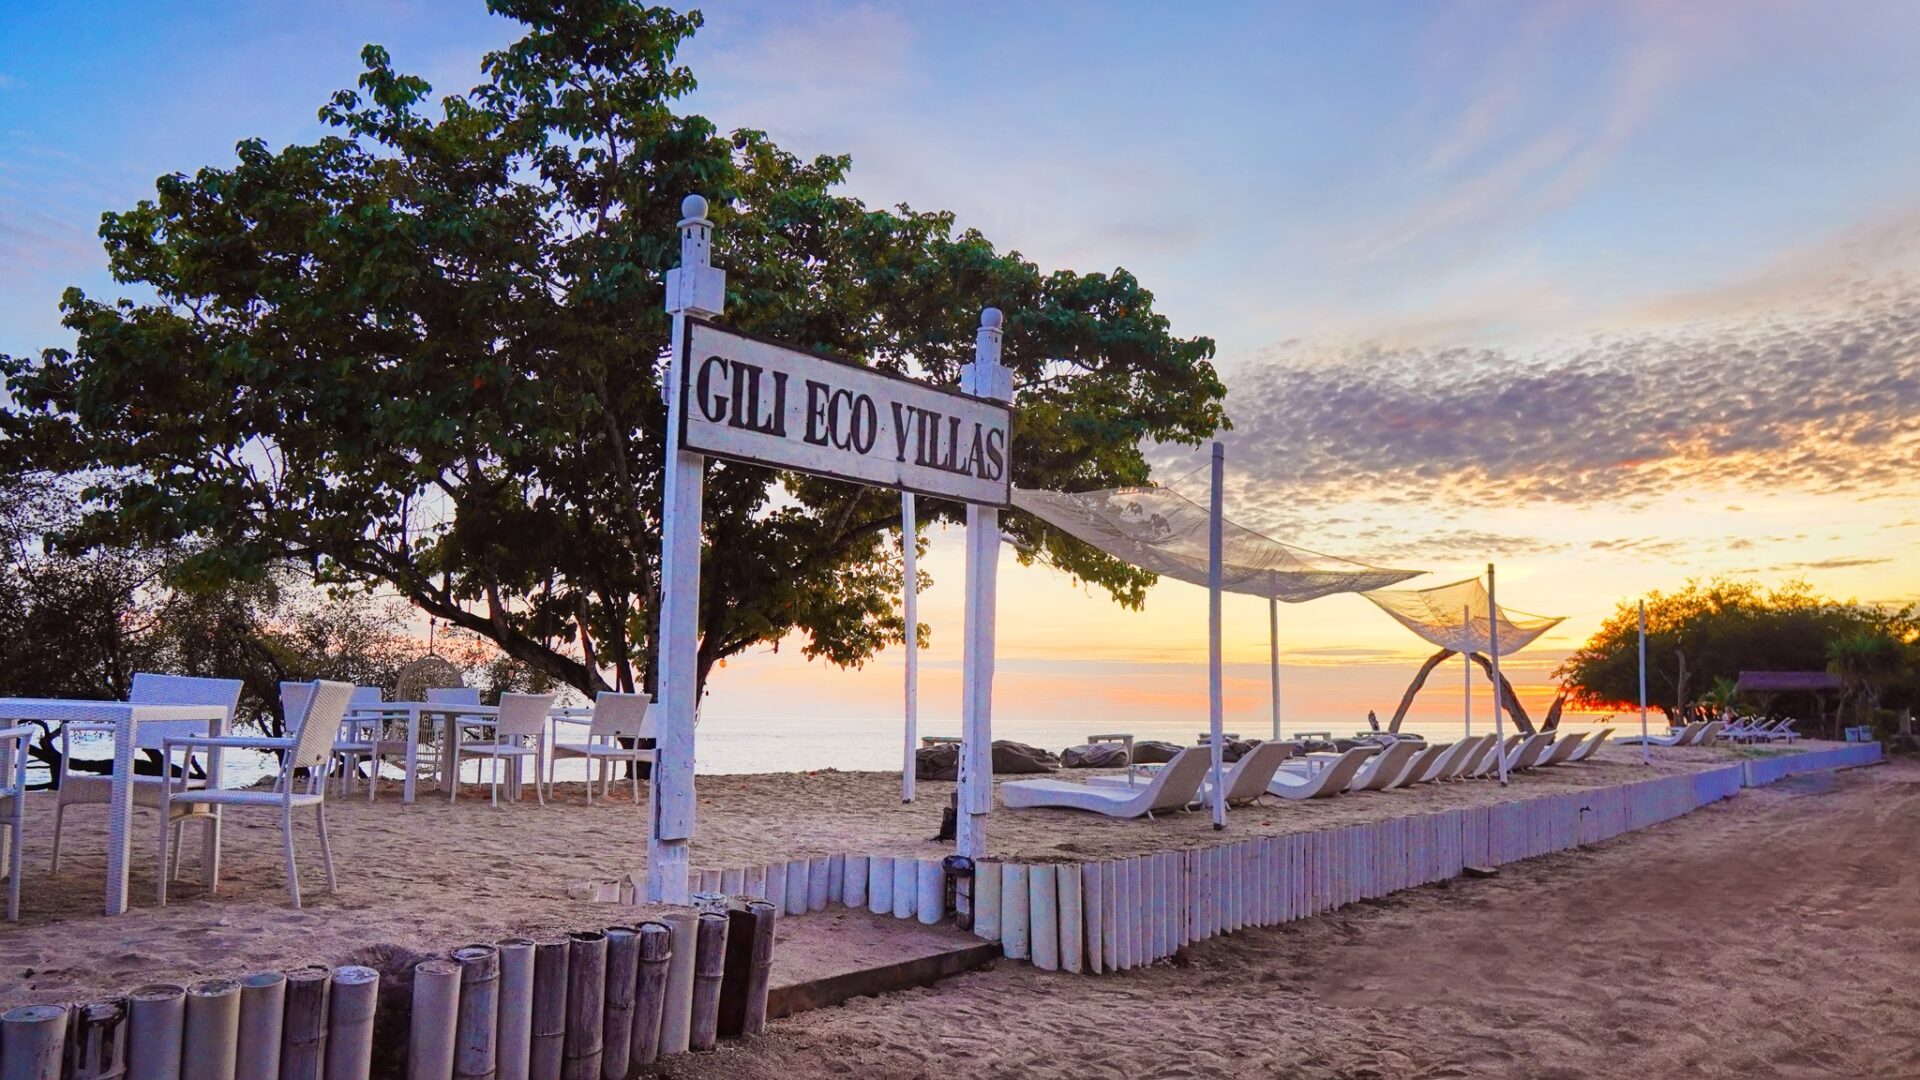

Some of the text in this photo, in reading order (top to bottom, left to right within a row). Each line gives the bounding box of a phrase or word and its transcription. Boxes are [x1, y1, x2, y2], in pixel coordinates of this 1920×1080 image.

[697, 356, 1004, 481] GILI ECO VILLAS
